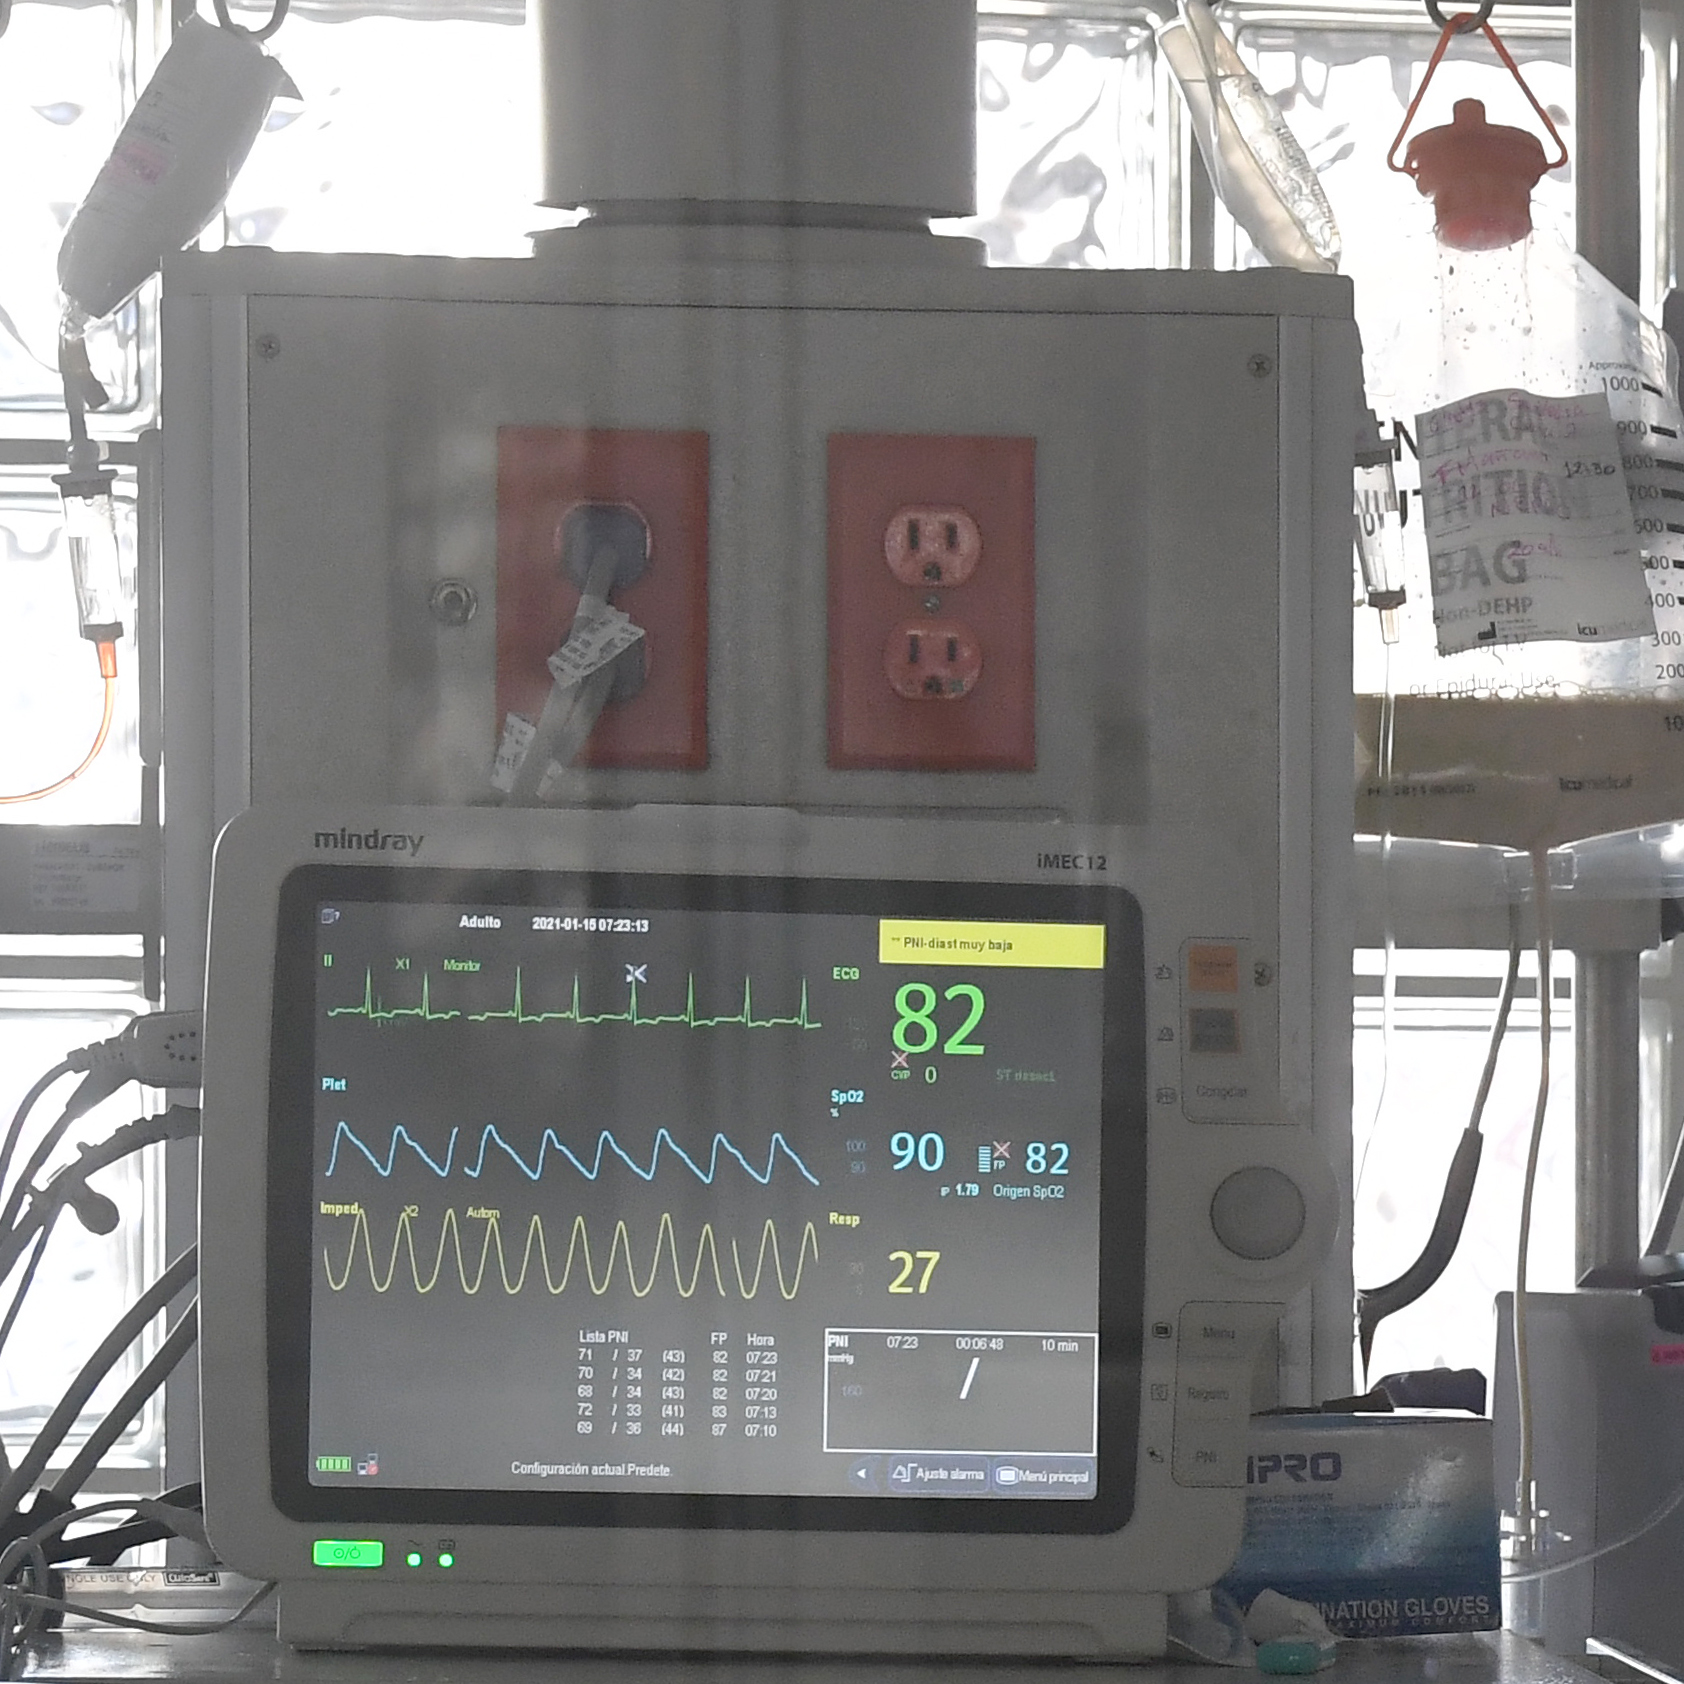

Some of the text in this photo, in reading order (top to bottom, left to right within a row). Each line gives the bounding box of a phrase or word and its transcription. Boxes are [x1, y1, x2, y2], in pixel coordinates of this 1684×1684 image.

[1602, 376, 1639, 393] 1000
[1616, 420, 1647, 436] 900
[1651, 630, 1682, 647] 300
[314, 827, 424, 856] mindray
[1036, 854, 1107, 871] iMEC12
[459, 914, 501, 929] Adulto
[959, 939, 985, 954] muy
[988, 938, 1013, 953] baja
[832, 967, 860, 981] ECG
[892, 982, 986, 1055] 82
[924, 1066, 938, 1084] 0
[831, 1089, 864, 1104] SpO2
[889, 1131, 945, 1171] 90
[1024, 1141, 1070, 1175] 82
[955, 1184, 980, 1196] 1.79
[993, 1184, 1065, 1199] Origen SpO2
[829, 1212, 860, 1227] Resp
[888, 1250, 941, 1294] 27
[579, 1330, 629, 1344] Lista PNI
[711, 1332, 728, 1345] FP
[747, 1333, 775, 1347] Hora
[828, 1335, 849, 1348] PNI
[1041, 1340, 1079, 1352] 10 min
[577, 1348, 593, 1361] 71
[626, 1349, 642, 1362] 37
[712, 1350, 728, 1363] 82
[577, 1366, 593, 1380] 70
[626, 1368, 642, 1380] 34
[712, 1369, 728, 1381] 82
[626, 1386, 642, 1398] 34
[712, 1387, 728, 1400] 82
[577, 1403, 593, 1416] 72
[626, 1404, 642, 1416] 33
[712, 1405, 728, 1418] 83
[712, 1424, 728, 1436] 87
[1404, 1595, 1490, 1617] GLOVES
